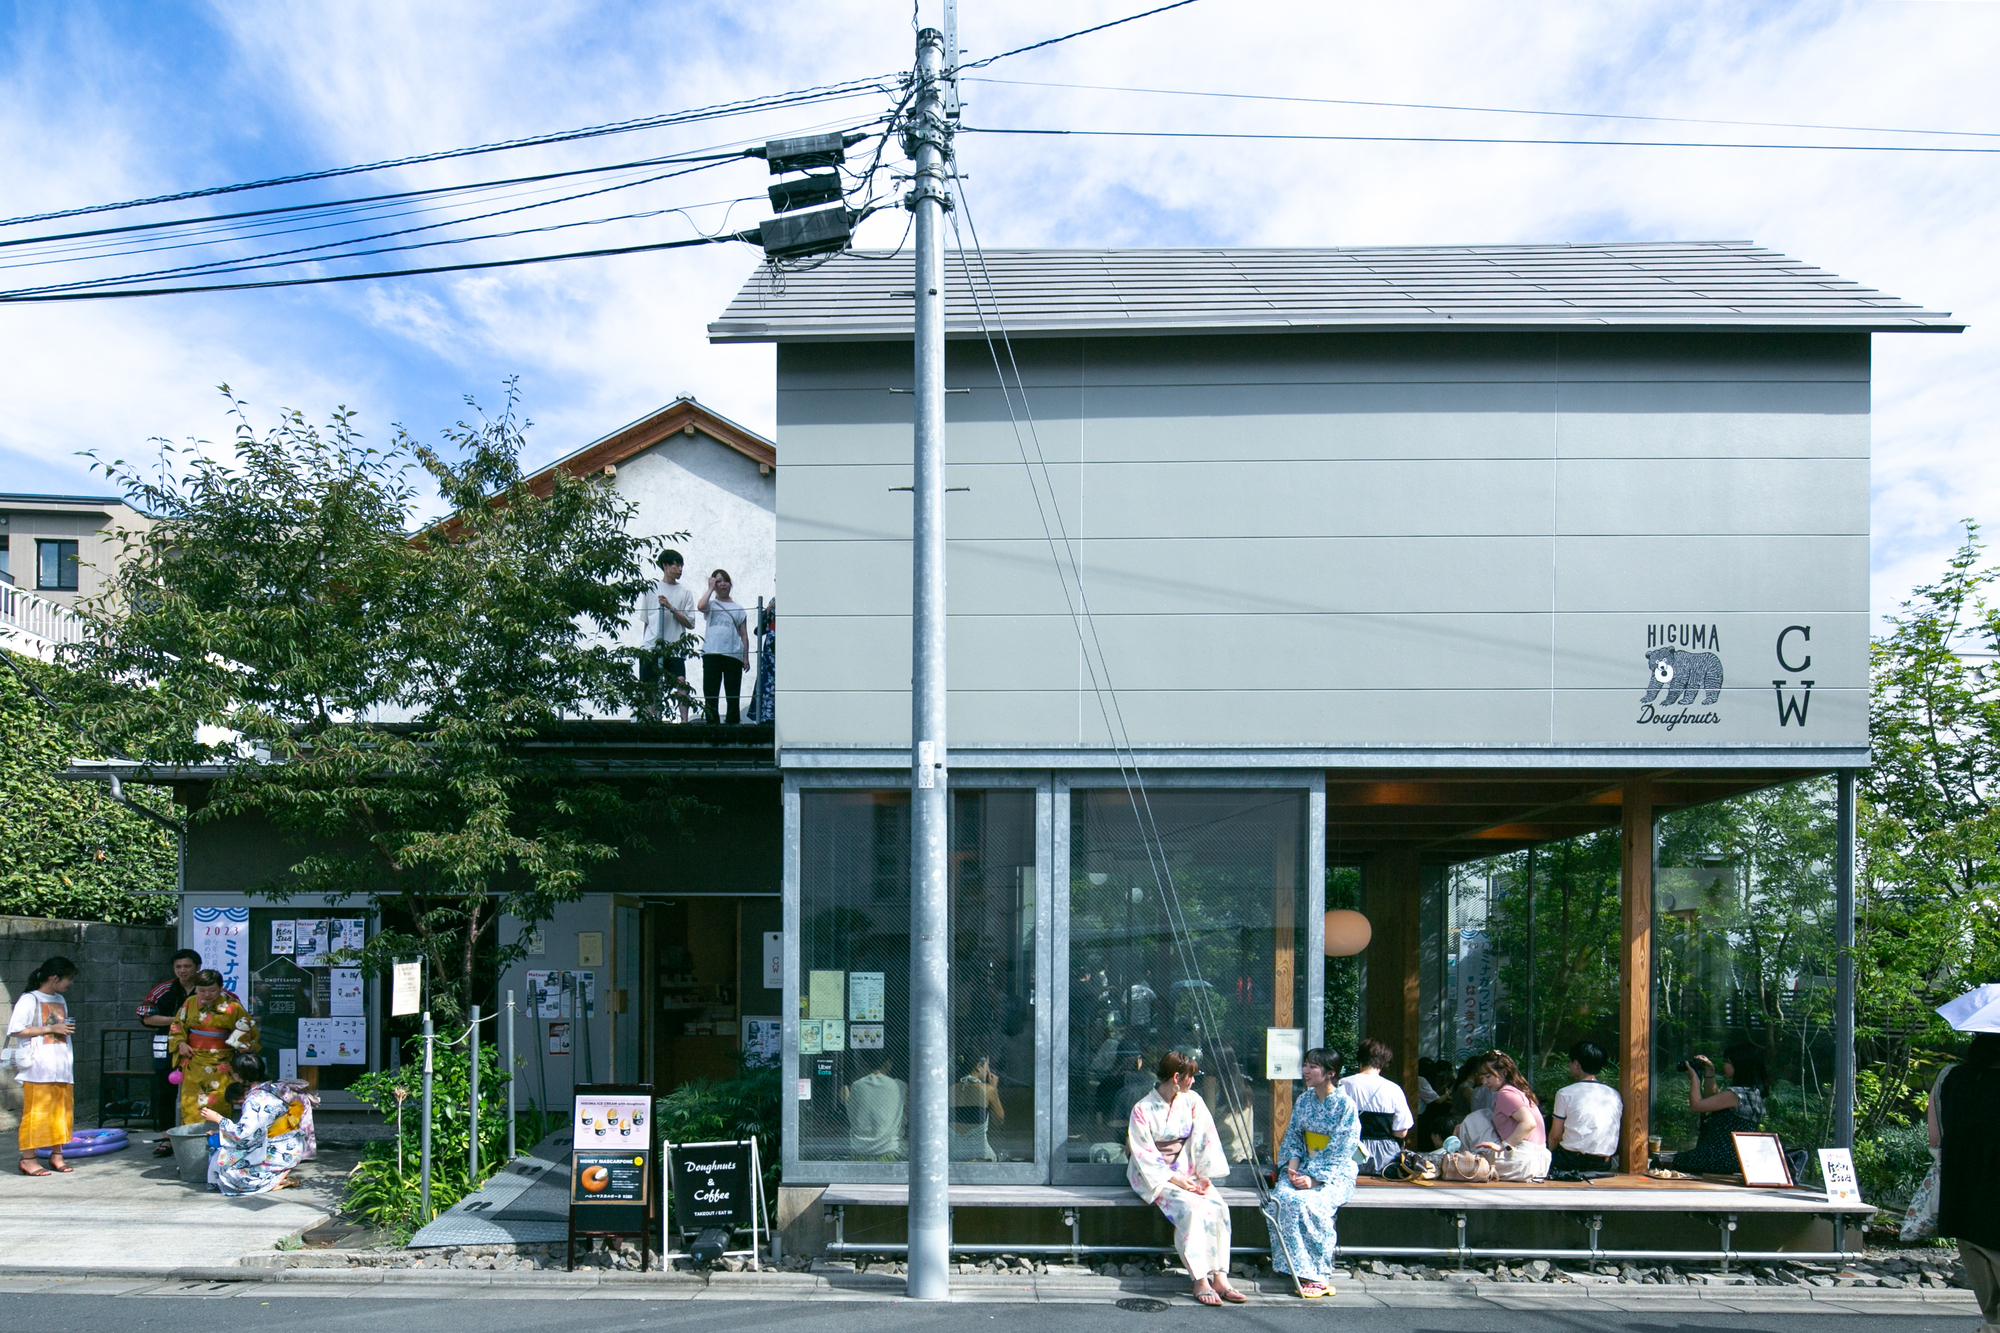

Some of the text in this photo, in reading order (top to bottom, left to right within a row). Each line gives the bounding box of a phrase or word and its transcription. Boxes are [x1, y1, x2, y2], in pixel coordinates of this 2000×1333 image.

[1647, 624, 1720, 652] HIGUMA
[1776, 625, 1811, 672] C
[1772, 680, 1815, 727] W
[1636, 703, 1721, 732] Doughnuts
[205, 926, 239, 936] 2023
[223, 939, 240, 992] ミナガ
[772, 956, 780, 965] C
[772, 965, 780, 974] W
[1464, 985, 1476, 1047] なつまつり
[684, 1160, 736, 1174] Doughnuts
[707, 1178, 715, 1187] &
[693, 1189, 730, 1204] Coffee
